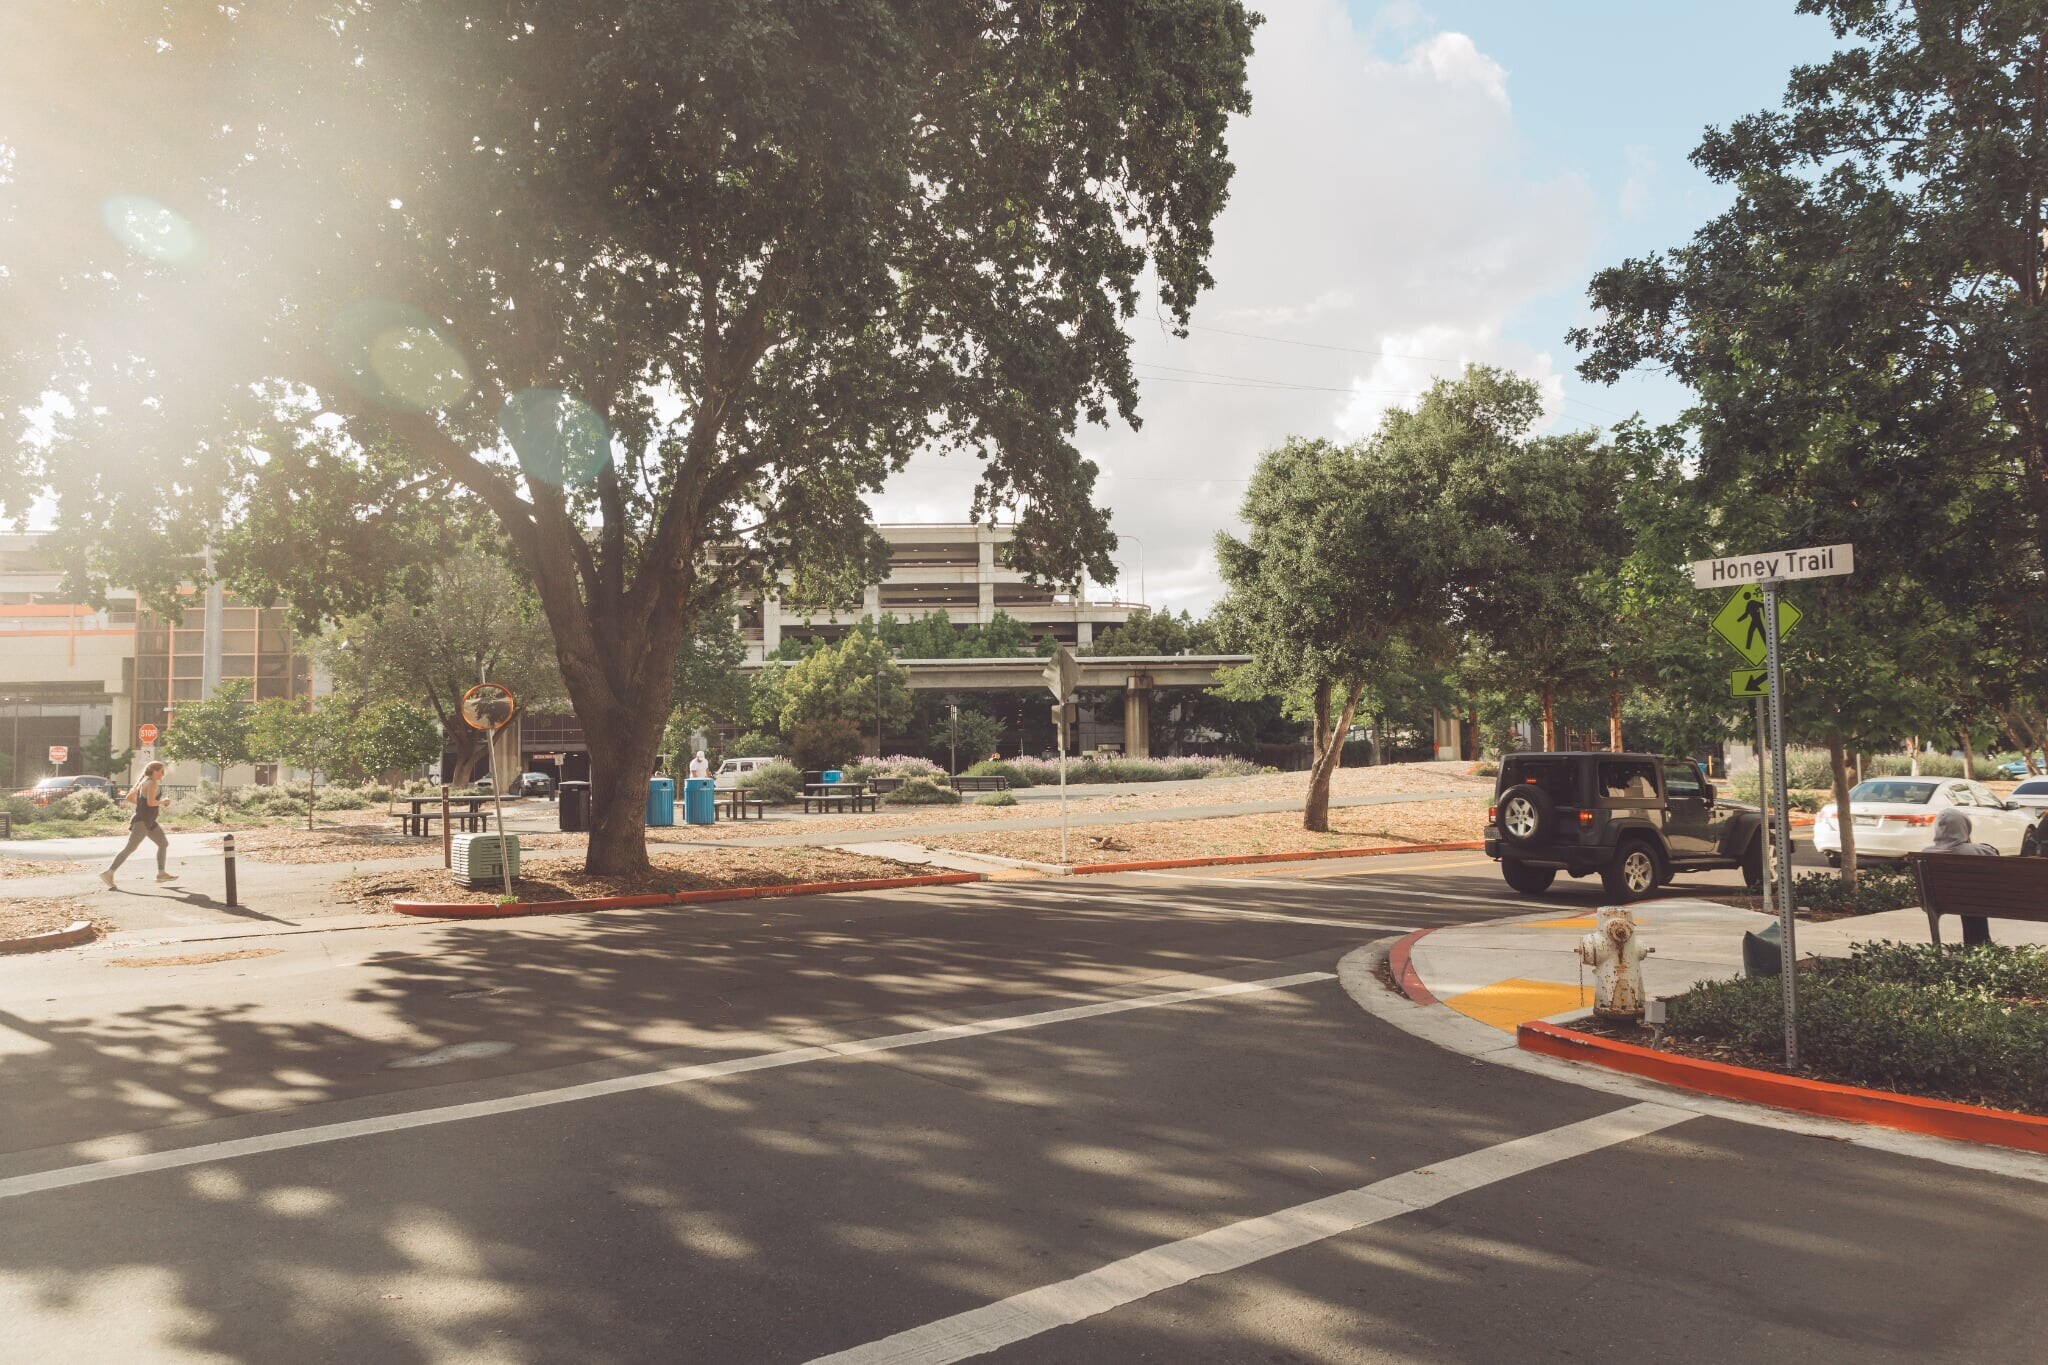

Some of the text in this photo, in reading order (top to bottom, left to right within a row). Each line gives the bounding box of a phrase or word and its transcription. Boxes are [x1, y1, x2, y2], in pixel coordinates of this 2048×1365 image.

[1712, 548, 1834, 580] Honey Trail
[140, 729, 156, 737] STOP
